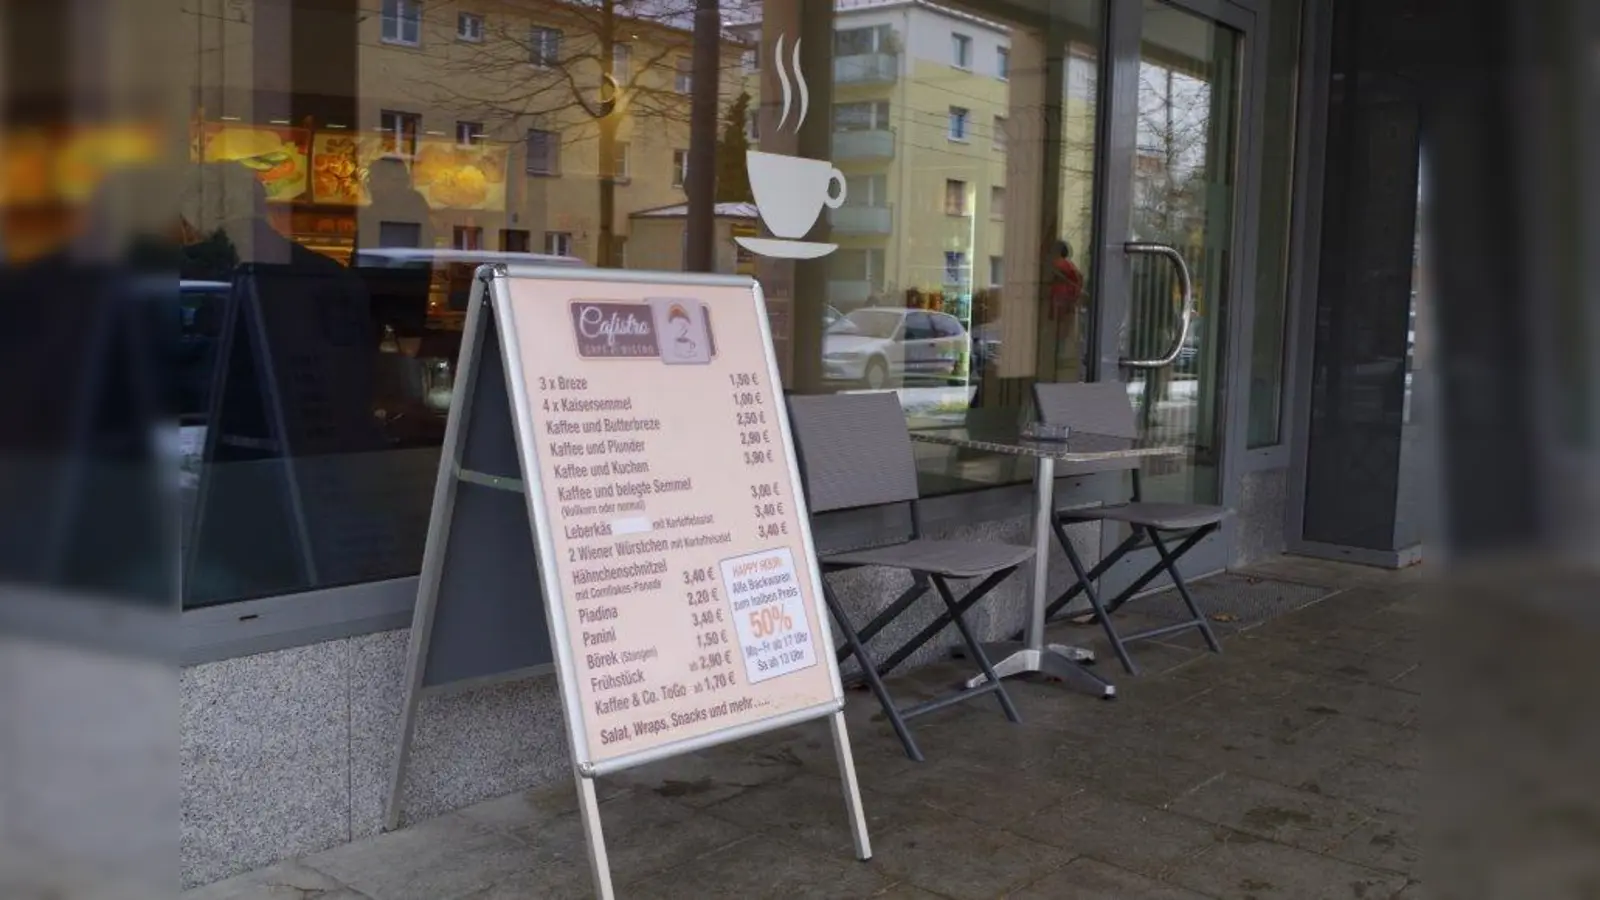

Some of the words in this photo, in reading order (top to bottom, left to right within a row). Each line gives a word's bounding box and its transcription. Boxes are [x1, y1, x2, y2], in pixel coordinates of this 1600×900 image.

[580, 306, 650, 346] Cafistro
[539, 376, 547, 391] 3
[549, 378, 556, 390] x
[557, 376, 588, 391] Breze
[752, 372, 760, 386] €
[543, 398, 550, 412] 4
[552, 401, 559, 412] x
[560, 397, 632, 412] Kaisersemmel
[733, 392, 753, 408] 1,00
[755, 391, 763, 405] €
[546, 419, 581, 435] Kaffee
[582, 418, 602, 433] und
[603, 417, 660, 433] Butterbreze
[736, 411, 758, 427] 2,50
[759, 410, 767, 425] €
[763, 429, 770, 444] €
[550, 440, 584, 457] Kaffee
[586, 439, 606, 455] und
[607, 439, 645, 454] Plunder
[766, 449, 773, 463] €
[554, 463, 589, 479] Kaffee
[590, 460, 610, 476] und
[611, 459, 650, 475] Kuchen
[557, 486, 592, 502] Kaffee
[594, 485, 613, 499] und
[615, 481, 651, 499] belegte
[653, 478, 692, 494] Semmel
[750, 484, 771, 500] 3,00
[773, 481, 781, 496] €
[598, 502, 615, 513] oder
[754, 503, 775, 519] 3,40
[777, 501, 785, 516] €
[564, 522, 612, 540] Leberkäs
[758, 522, 780, 539] 3,40
[781, 520, 788, 535] €
[569, 548, 576, 562] 2
[578, 546, 612, 560] Wiener
[615, 539, 669, 556] Würstchen
[572, 558, 668, 585] Hähnchenschnitzel
[683, 568, 705, 586] 3,40
[707, 566, 715, 581] €
[733, 579, 748, 594] Alle
[748, 573, 790, 590] Backwaren
[687, 589, 710, 606] 2,20
[711, 587, 720, 601] €
[777, 587, 798, 600] Preis
[579, 606, 618, 624] Piadina
[691, 610, 714, 628] 3,40
[715, 608, 724, 622] €
[749, 603, 793, 639] 50%
[582, 626, 617, 647] Panini
[697, 631, 719, 649] 1,50
[720, 629, 729, 643] €
[586, 651, 619, 670] Börek
[724, 650, 732, 665] €
[590, 669, 646, 692] Frühstück
[595, 696, 630, 716] Kaffee
[631, 689, 640, 707] &
[642, 690, 660, 705] Co.
[661, 683, 687, 700] ToGo
[704, 673, 727, 692] 1,70
[728, 671, 736, 685] €
[600, 725, 632, 745] Salat,
[633, 718, 670, 736] Wraps,
[671, 708, 708, 727] Snacks
[709, 701, 728, 718] und
